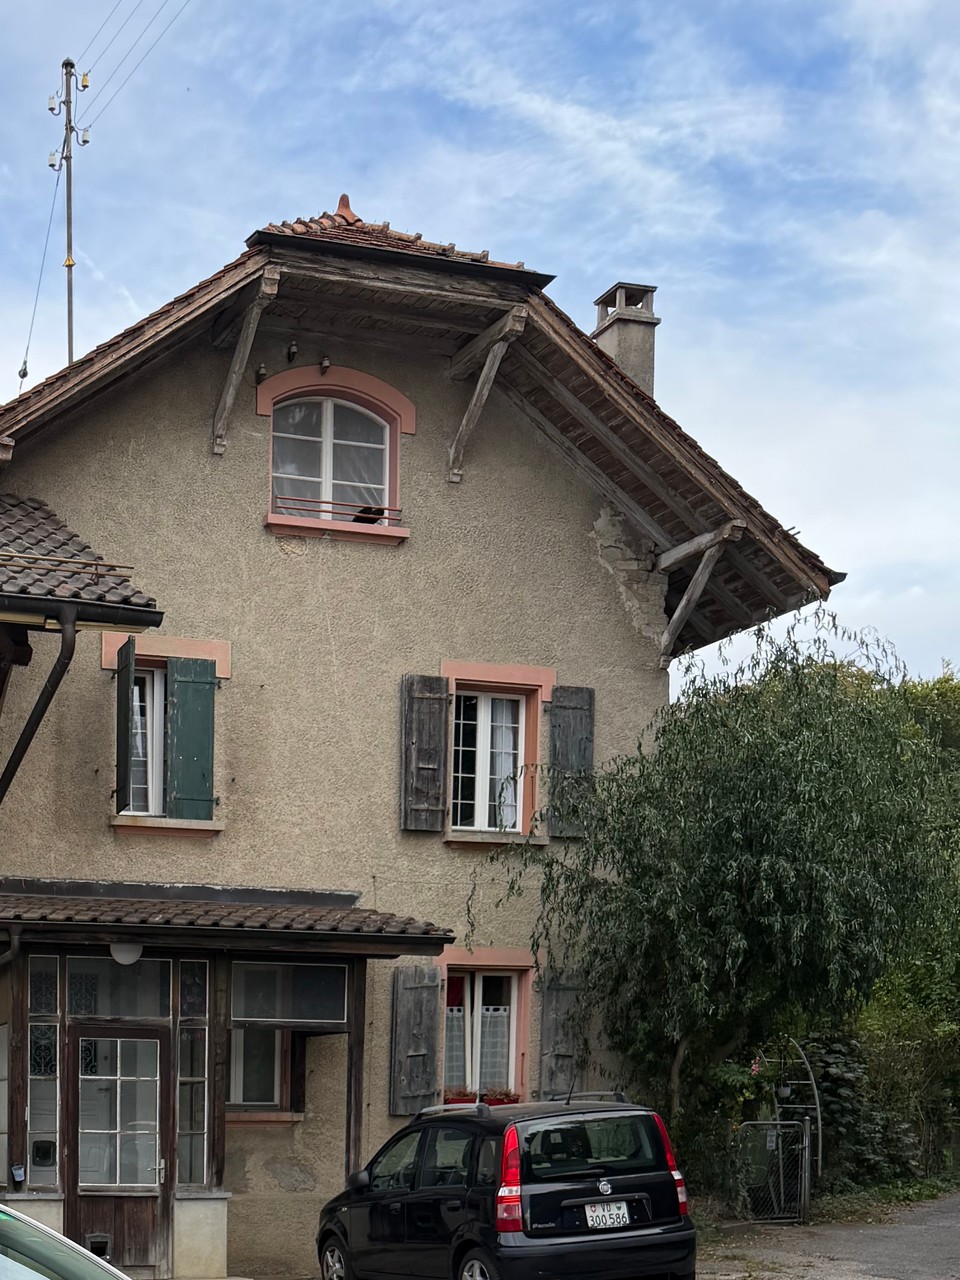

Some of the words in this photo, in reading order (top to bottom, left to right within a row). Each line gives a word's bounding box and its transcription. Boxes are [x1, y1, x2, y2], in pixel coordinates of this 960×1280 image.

[601, 1203, 611, 1212] VD
[589, 1215, 607, 1227] 300
[609, 1213, 627, 1225] 586
